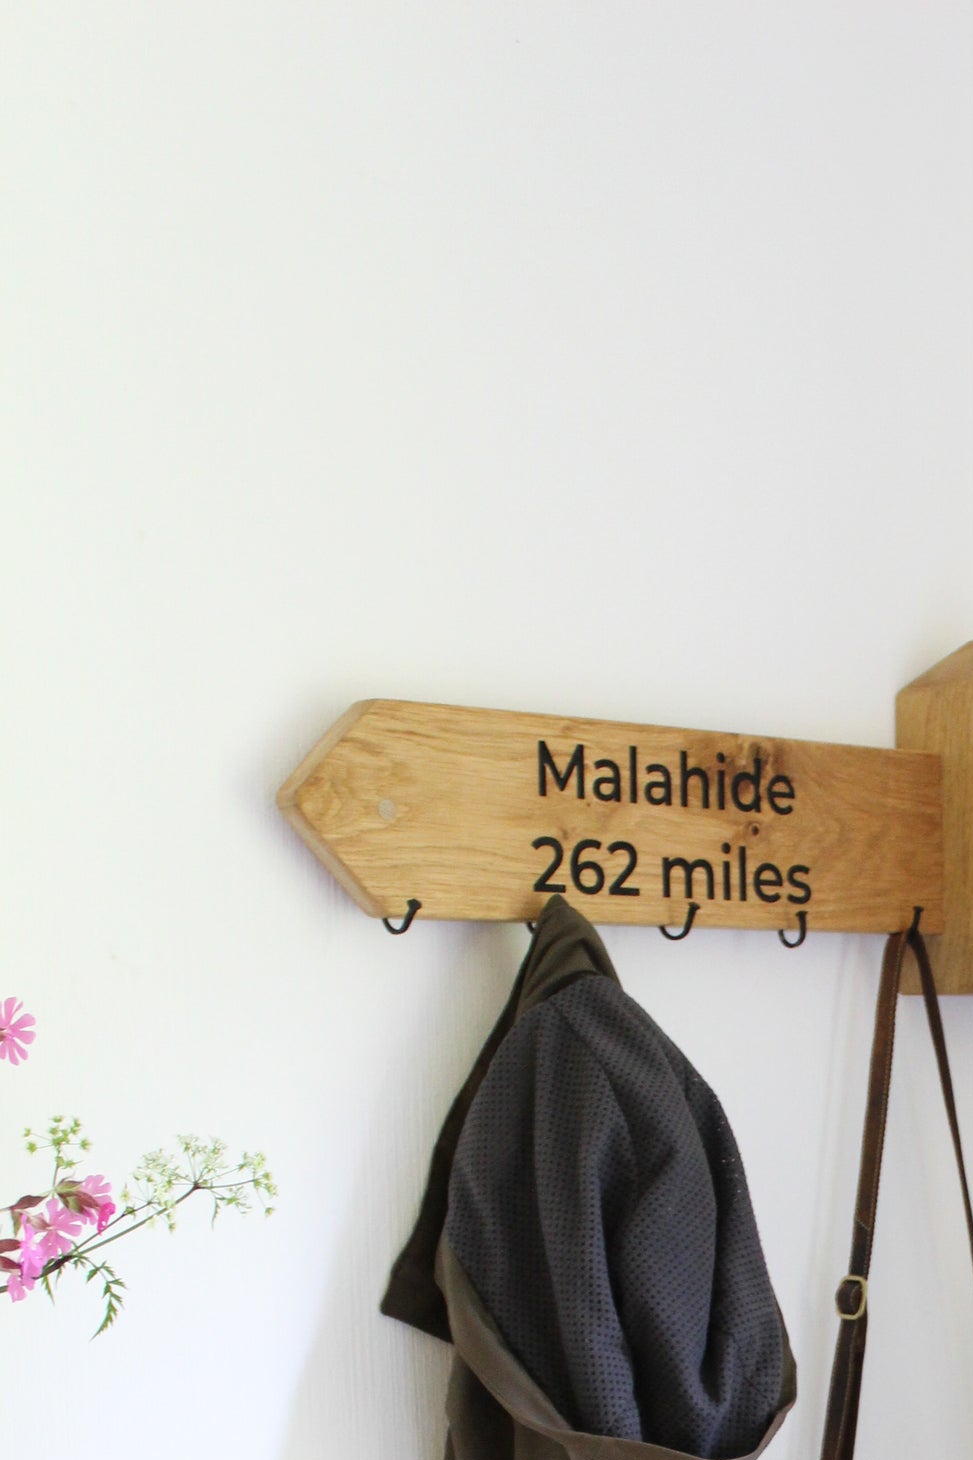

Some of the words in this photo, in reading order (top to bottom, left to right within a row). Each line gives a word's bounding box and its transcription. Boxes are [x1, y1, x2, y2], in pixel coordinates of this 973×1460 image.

[538, 740, 795, 815] Malahide
[531, 836, 640, 895] 262
[662, 842, 812, 904] miles
